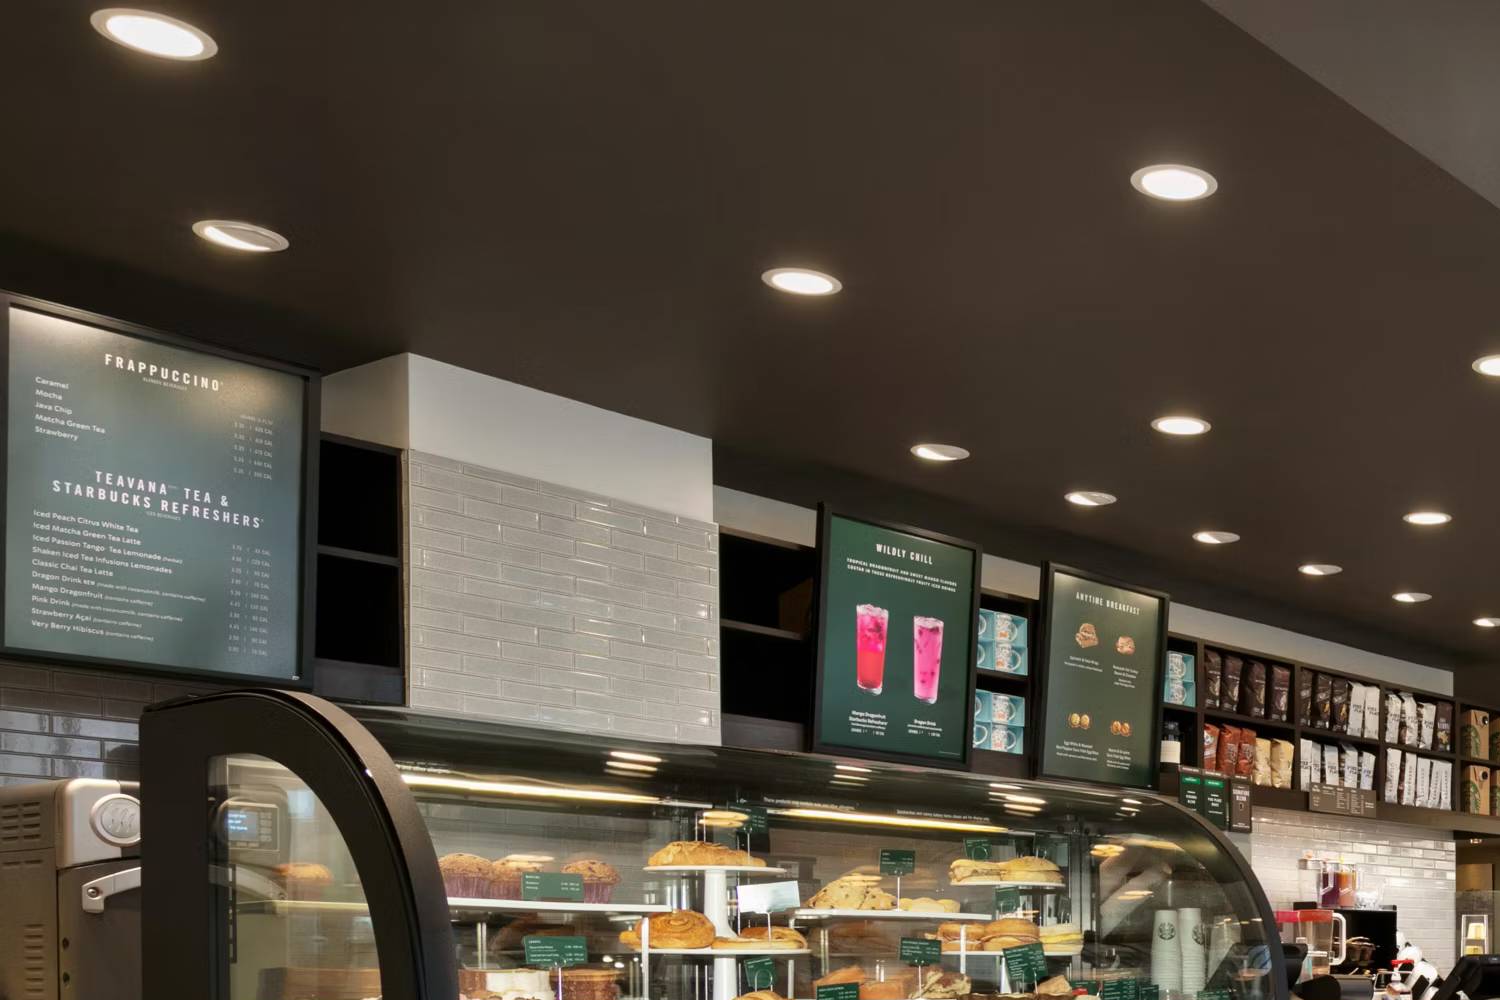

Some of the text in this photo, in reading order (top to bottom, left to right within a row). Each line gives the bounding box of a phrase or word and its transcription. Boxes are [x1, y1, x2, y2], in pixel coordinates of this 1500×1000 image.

[104, 353, 220, 391] FRAPPUCCINO
[35, 376, 69, 390] Caramel
[35, 388, 63, 400] Mocha
[34, 401, 73, 415] Java Chip
[35, 413, 106, 434] Matcha Green Tea
[35, 425, 79, 441] Strawberry
[95, 470, 229, 507] TEAVANA TEA &
[52, 480, 261, 529] STARBUCKS REFRESHERS
[33, 509, 139, 534] Iced Peach Citrus White Tea
[33, 522, 142, 546] Iced Matcha Green Tea Latte
[32, 534, 50, 544] Iced
[51, 537, 81, 548] Passion
[82, 542, 105, 553] Tango
[109, 546, 121, 555] Tea
[123, 548, 162, 561] Lemonade
[876, 543, 933, 565] WILDLY CHILL
[32, 546, 172, 575] Shaken Iced Tea Infusions Lemonades
[32, 558, 114, 577] Classic Chai Tea Latte
[32, 571, 60, 581] Dragon
[61, 575, 81, 584] Drink
[32, 583, 58, 593] Mango
[60, 587, 103, 600] Dragonfruit
[32, 595, 49, 604] Pink
[50, 597, 70, 607] Drink
[1076, 592, 1140, 615] ANYTIME BREAKFAST
[32, 608, 74, 620] Strawberry
[32, 619, 49, 629] Very
[50, 622, 71, 632] Berry
[73, 625, 104, 636] Hibiscus
